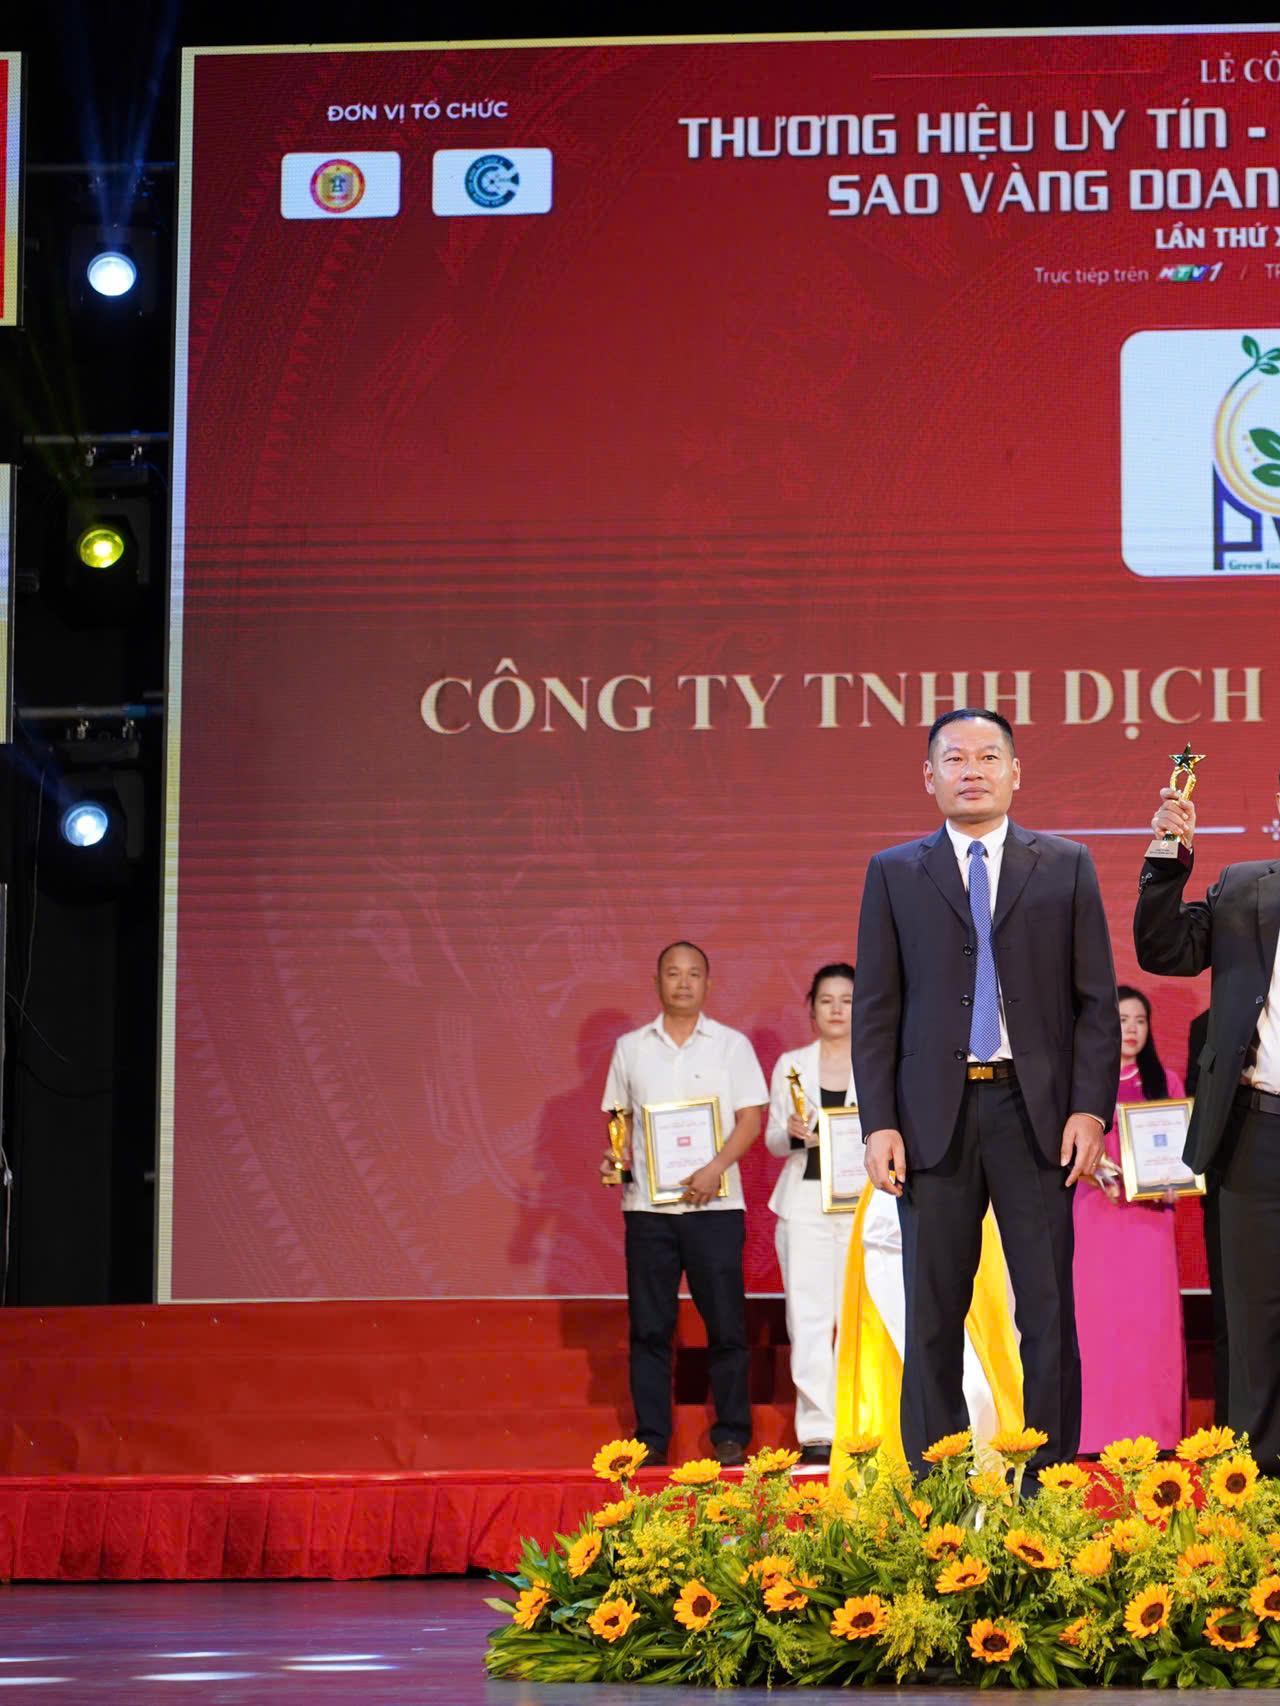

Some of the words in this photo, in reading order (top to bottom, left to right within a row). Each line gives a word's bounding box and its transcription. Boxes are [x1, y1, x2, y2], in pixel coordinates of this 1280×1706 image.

[327, 102, 377, 121] ĐƠN
[383, 104, 405, 124] VỊ
[446, 98, 508, 119] CHỨC
[678, 114, 896, 158] THƯƠNG
[918, 103, 1033, 160] HIỆU
[1055, 110, 1125, 151] UY
[1147, 98, 1226, 149] TÍN
[1248, 127, 1265, 137] -
[829, 174, 938, 215] SAO
[960, 163, 1108, 213] VÀNG
[1156, 222, 1205, 249] LẦN
[1214, 223, 1268, 248] THỨ
[1034, 265, 1070, 285] Trực
[1229, 560, 1263, 570] Green
[421, 658, 652, 734] CÔNG
[678, 675, 782, 729] TY
[805, 671, 1032, 727] TNHH
[1064, 668, 1262, 739] DỊCH
